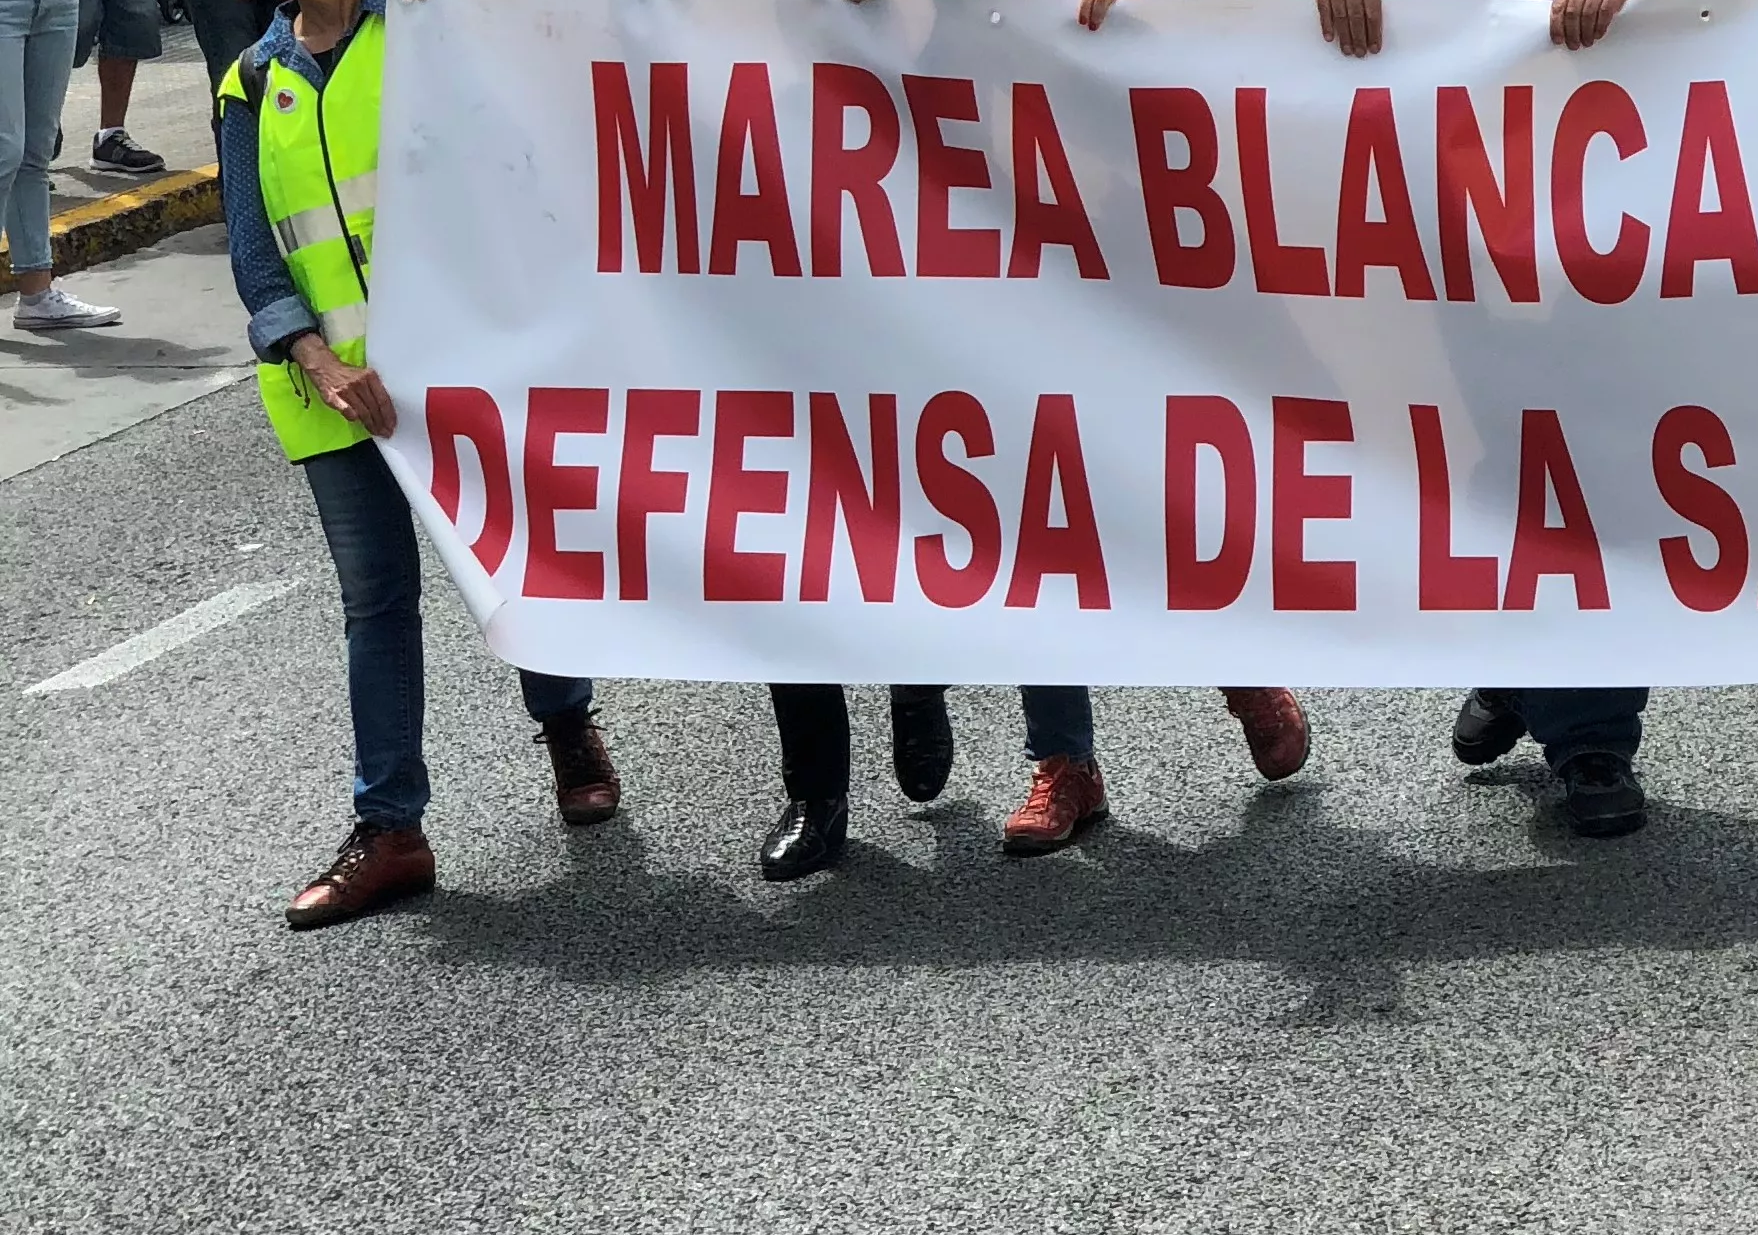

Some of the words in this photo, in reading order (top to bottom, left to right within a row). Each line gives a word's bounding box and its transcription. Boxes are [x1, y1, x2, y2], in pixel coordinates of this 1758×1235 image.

[593, 62, 1107, 278] MAREA
[427, 388, 1110, 610] DEFENSA
[1166, 397, 1357, 611] DE
[1411, 406, 1610, 612] LA
